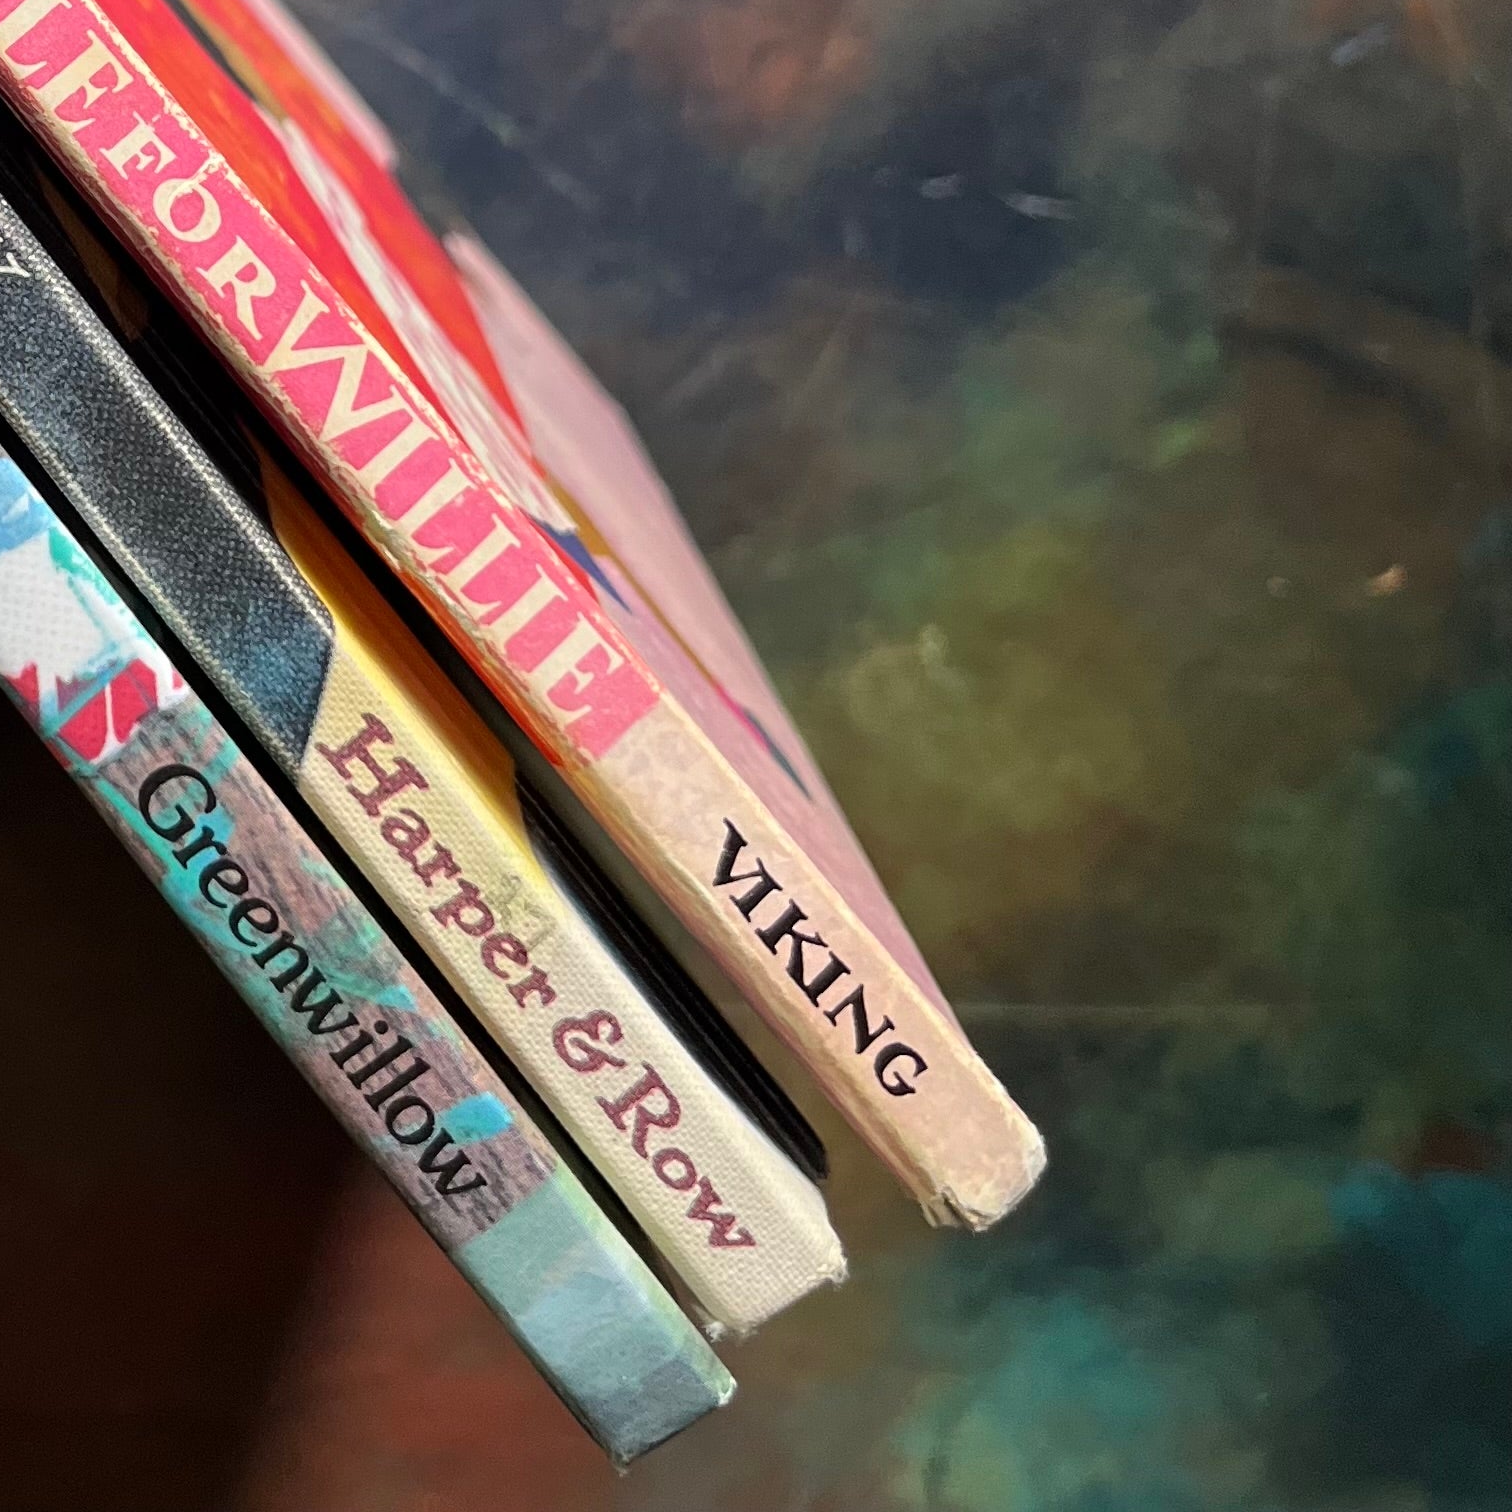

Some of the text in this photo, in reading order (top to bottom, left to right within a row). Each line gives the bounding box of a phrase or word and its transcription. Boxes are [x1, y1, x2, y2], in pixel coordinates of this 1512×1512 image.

[98, 110, 280, 342] FOR
[258, 278, 626, 724] WILLIE
[136, 762, 488, 1206] Greenwillow
[316, 710, 558, 1012] Harper
[550, 1008, 628, 1076] &
[596, 1062, 758, 1254] Row
[710, 816, 930, 1100] VIKING
